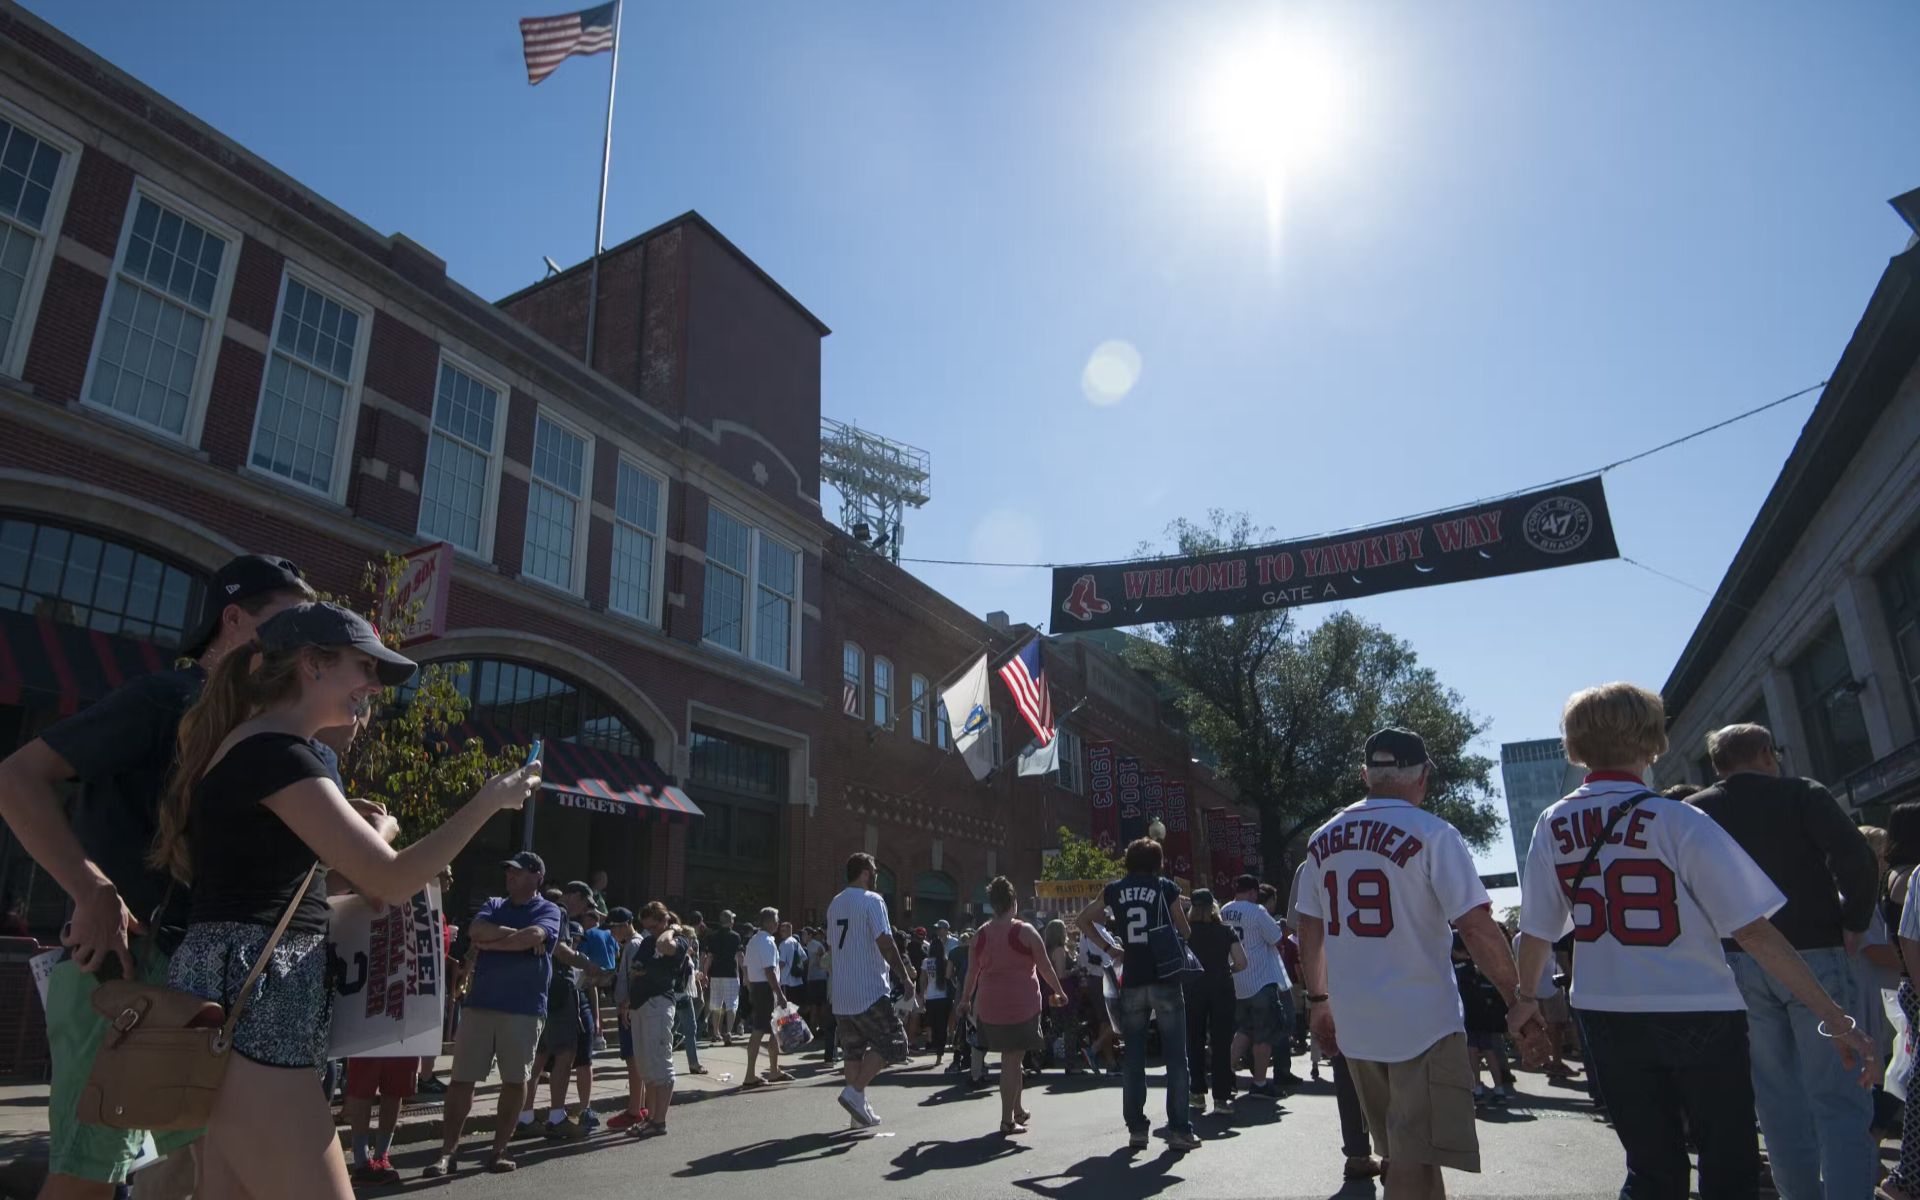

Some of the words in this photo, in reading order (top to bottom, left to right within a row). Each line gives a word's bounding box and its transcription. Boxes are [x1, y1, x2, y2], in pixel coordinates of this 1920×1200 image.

[1122, 559, 1248, 599] WELCOME
[1255, 552, 1295, 585] TO
[1300, 528, 1424, 578] YAWKEY
[1432, 510, 1503, 553] WAY
[1262, 585, 1313, 605] GATE
[1322, 582, 1338, 597] A
[1089, 746, 1113, 810] 1903
[1118, 760, 1141, 820] 1904
[1142, 775, 1165, 822] 1912
[556, 792, 627, 816] TICKETS
[1166, 785, 1188, 833] 1915
[1307, 820, 1423, 869] TOGETHER
[1550, 806, 1657, 855] SINCE
[1118, 886, 1157, 904] JETER
[1324, 868, 1395, 938] 19
[1554, 858, 1682, 948] 58
[402, 902, 419, 997] 93.7FM
[411, 889, 437, 997] WEEI
[836, 918, 849, 950] 7
[1126, 906, 1149, 944] 2
[365, 917, 389, 1019] FAMER
[385, 980, 405, 1021] OF
